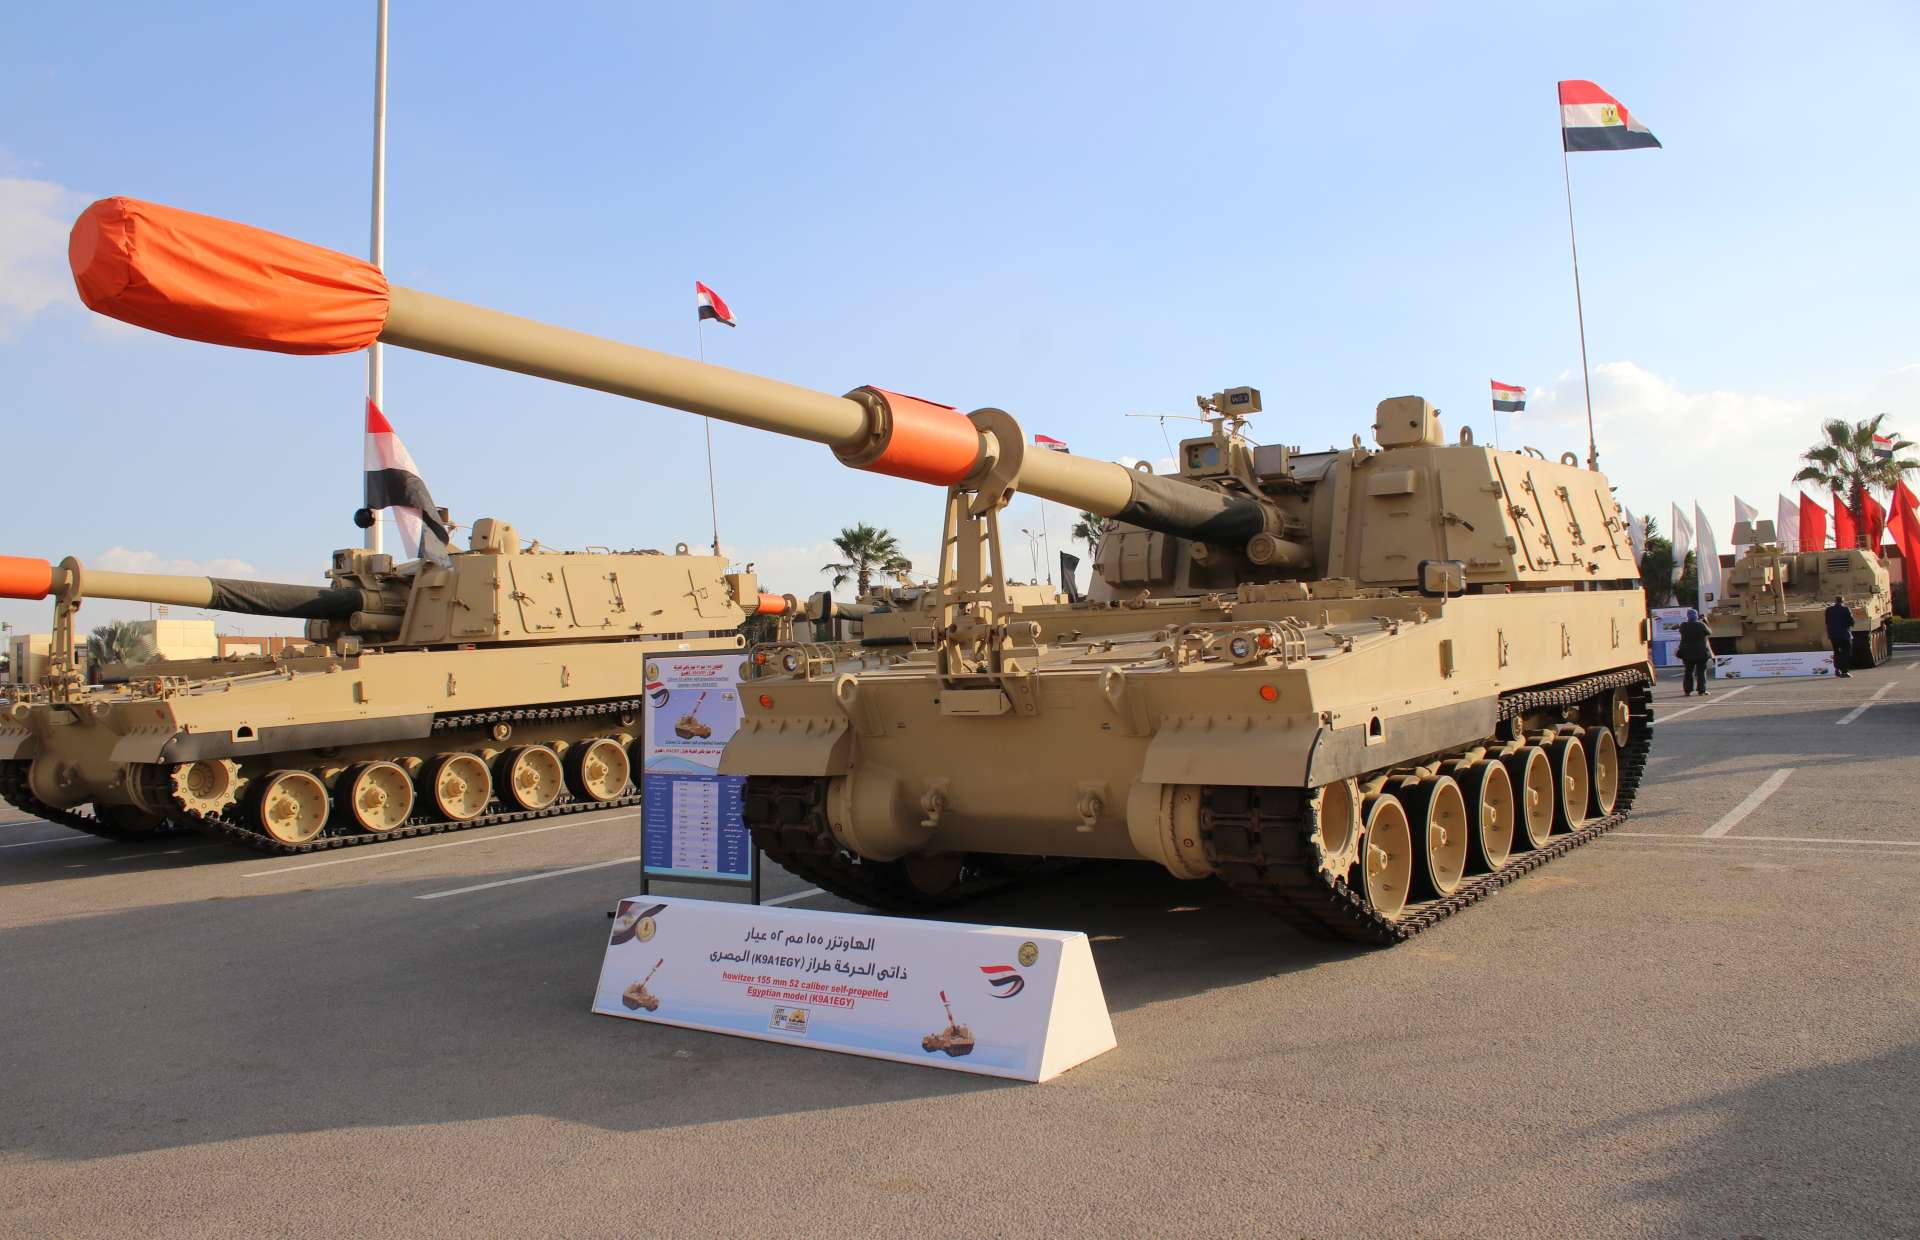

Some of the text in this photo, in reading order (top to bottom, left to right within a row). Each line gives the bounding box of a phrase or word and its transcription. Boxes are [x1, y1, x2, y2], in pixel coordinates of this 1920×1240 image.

[744, 927, 767, 943] عيار
[784, 934, 803, 946] مم
[824, 936, 876, 951] الهاوتزر
[751, 954, 805, 970] (K9A1EGY)
[805, 957, 831, 973] طراز
[834, 959, 876, 977] الحركة
[722, 970, 755, 983] howitzer
[756, 975, 771, 984] 155
[789, 979, 799, 988] 52
[801, 981, 828, 992] caliber
[831, 984, 889, 1000] self-propelled
[747, 986, 855, 1010] Egyptian model (K9A1EGY)
